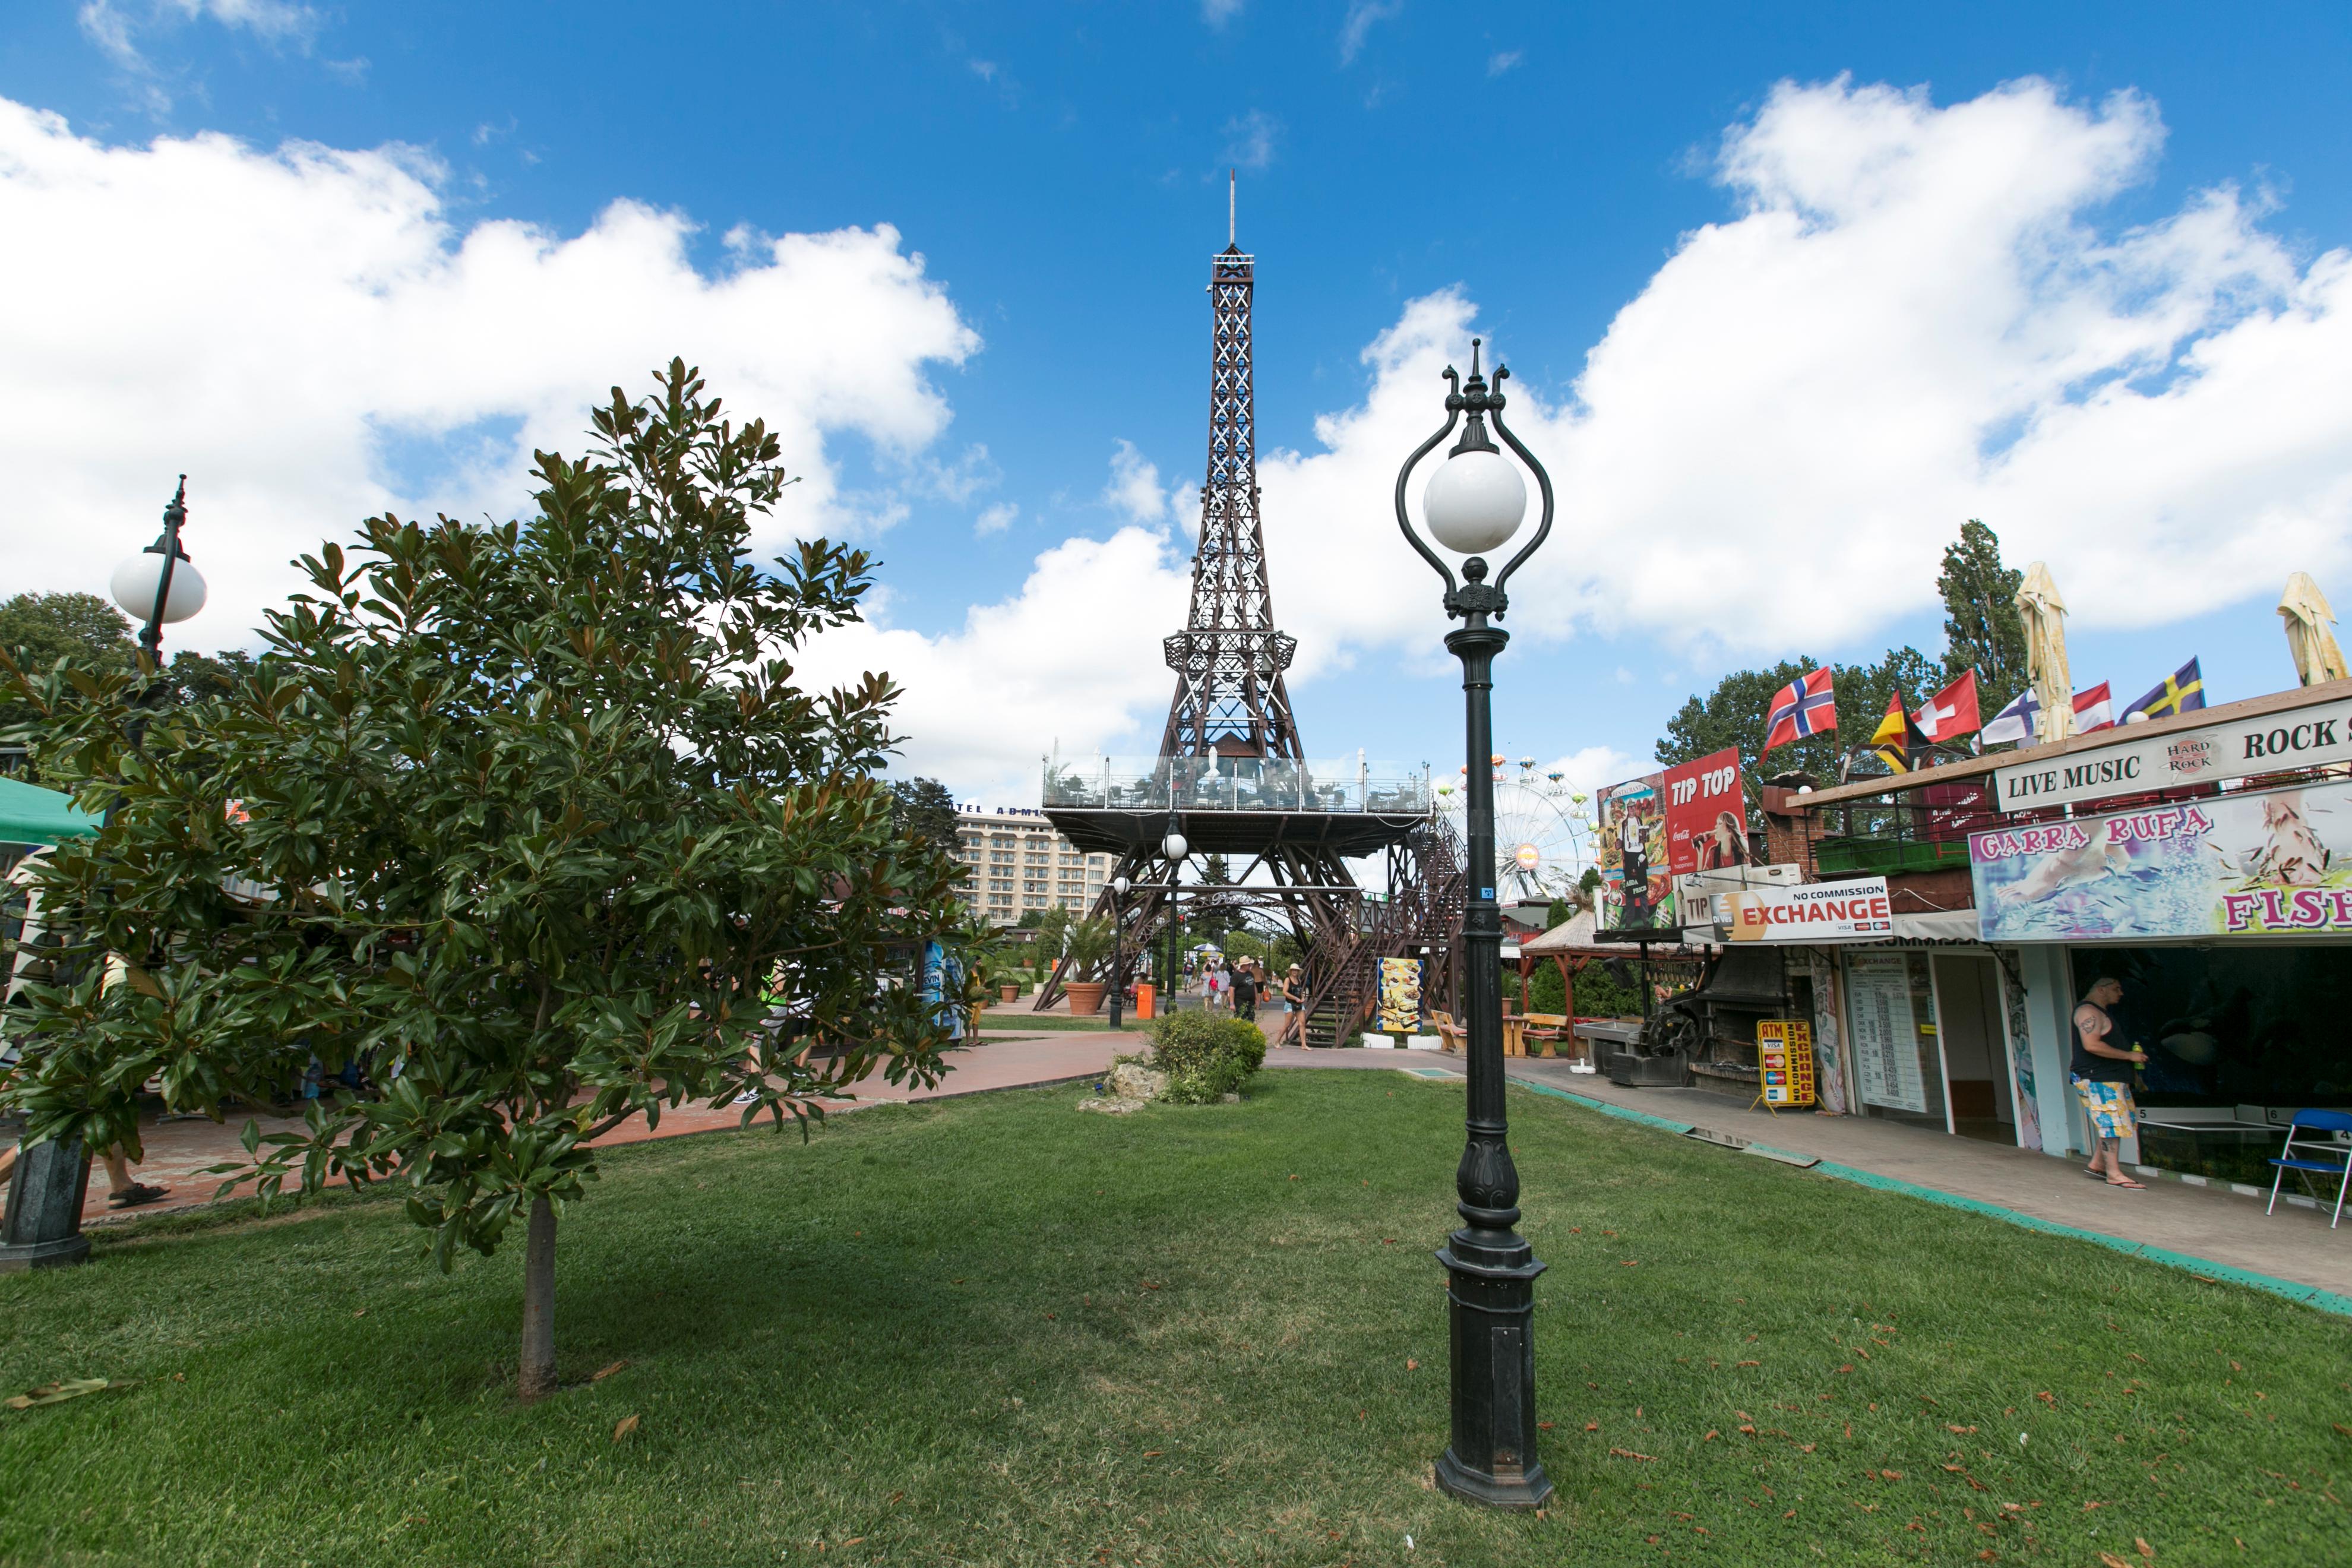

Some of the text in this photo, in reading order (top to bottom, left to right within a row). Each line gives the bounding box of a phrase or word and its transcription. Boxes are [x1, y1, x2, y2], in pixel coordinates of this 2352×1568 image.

[2243, 719, 2338, 759] ROCK
[2167, 742, 2209, 756] HARD
[2169, 757, 2212, 771] ROCK
[2008, 755, 2141, 799] LIVE MUSIC
[1671, 766, 1735, 806] TIP TOP
[947, 802, 982, 813] OTEL
[1980, 805, 2214, 859] GARRA RUFA
[1674, 861, 1695, 870] happiness
[1211, 891, 1254, 905] Paris
[1793, 886, 1884, 901] NO COMMISSION
[1687, 897, 1708, 921] TIP
[1743, 897, 1889, 925] EXCHANGE
[1762, 1023, 1784, 1037] ATM
[1787, 1023, 1800, 1101] NO COMMISSION
[1795, 1023, 1812, 1101] EXCHANGE
[2139, 1109, 2146, 1119] 5
[2270, 1109, 2277, 1119] 6
[2340, 1130, 2351, 1140] 4
